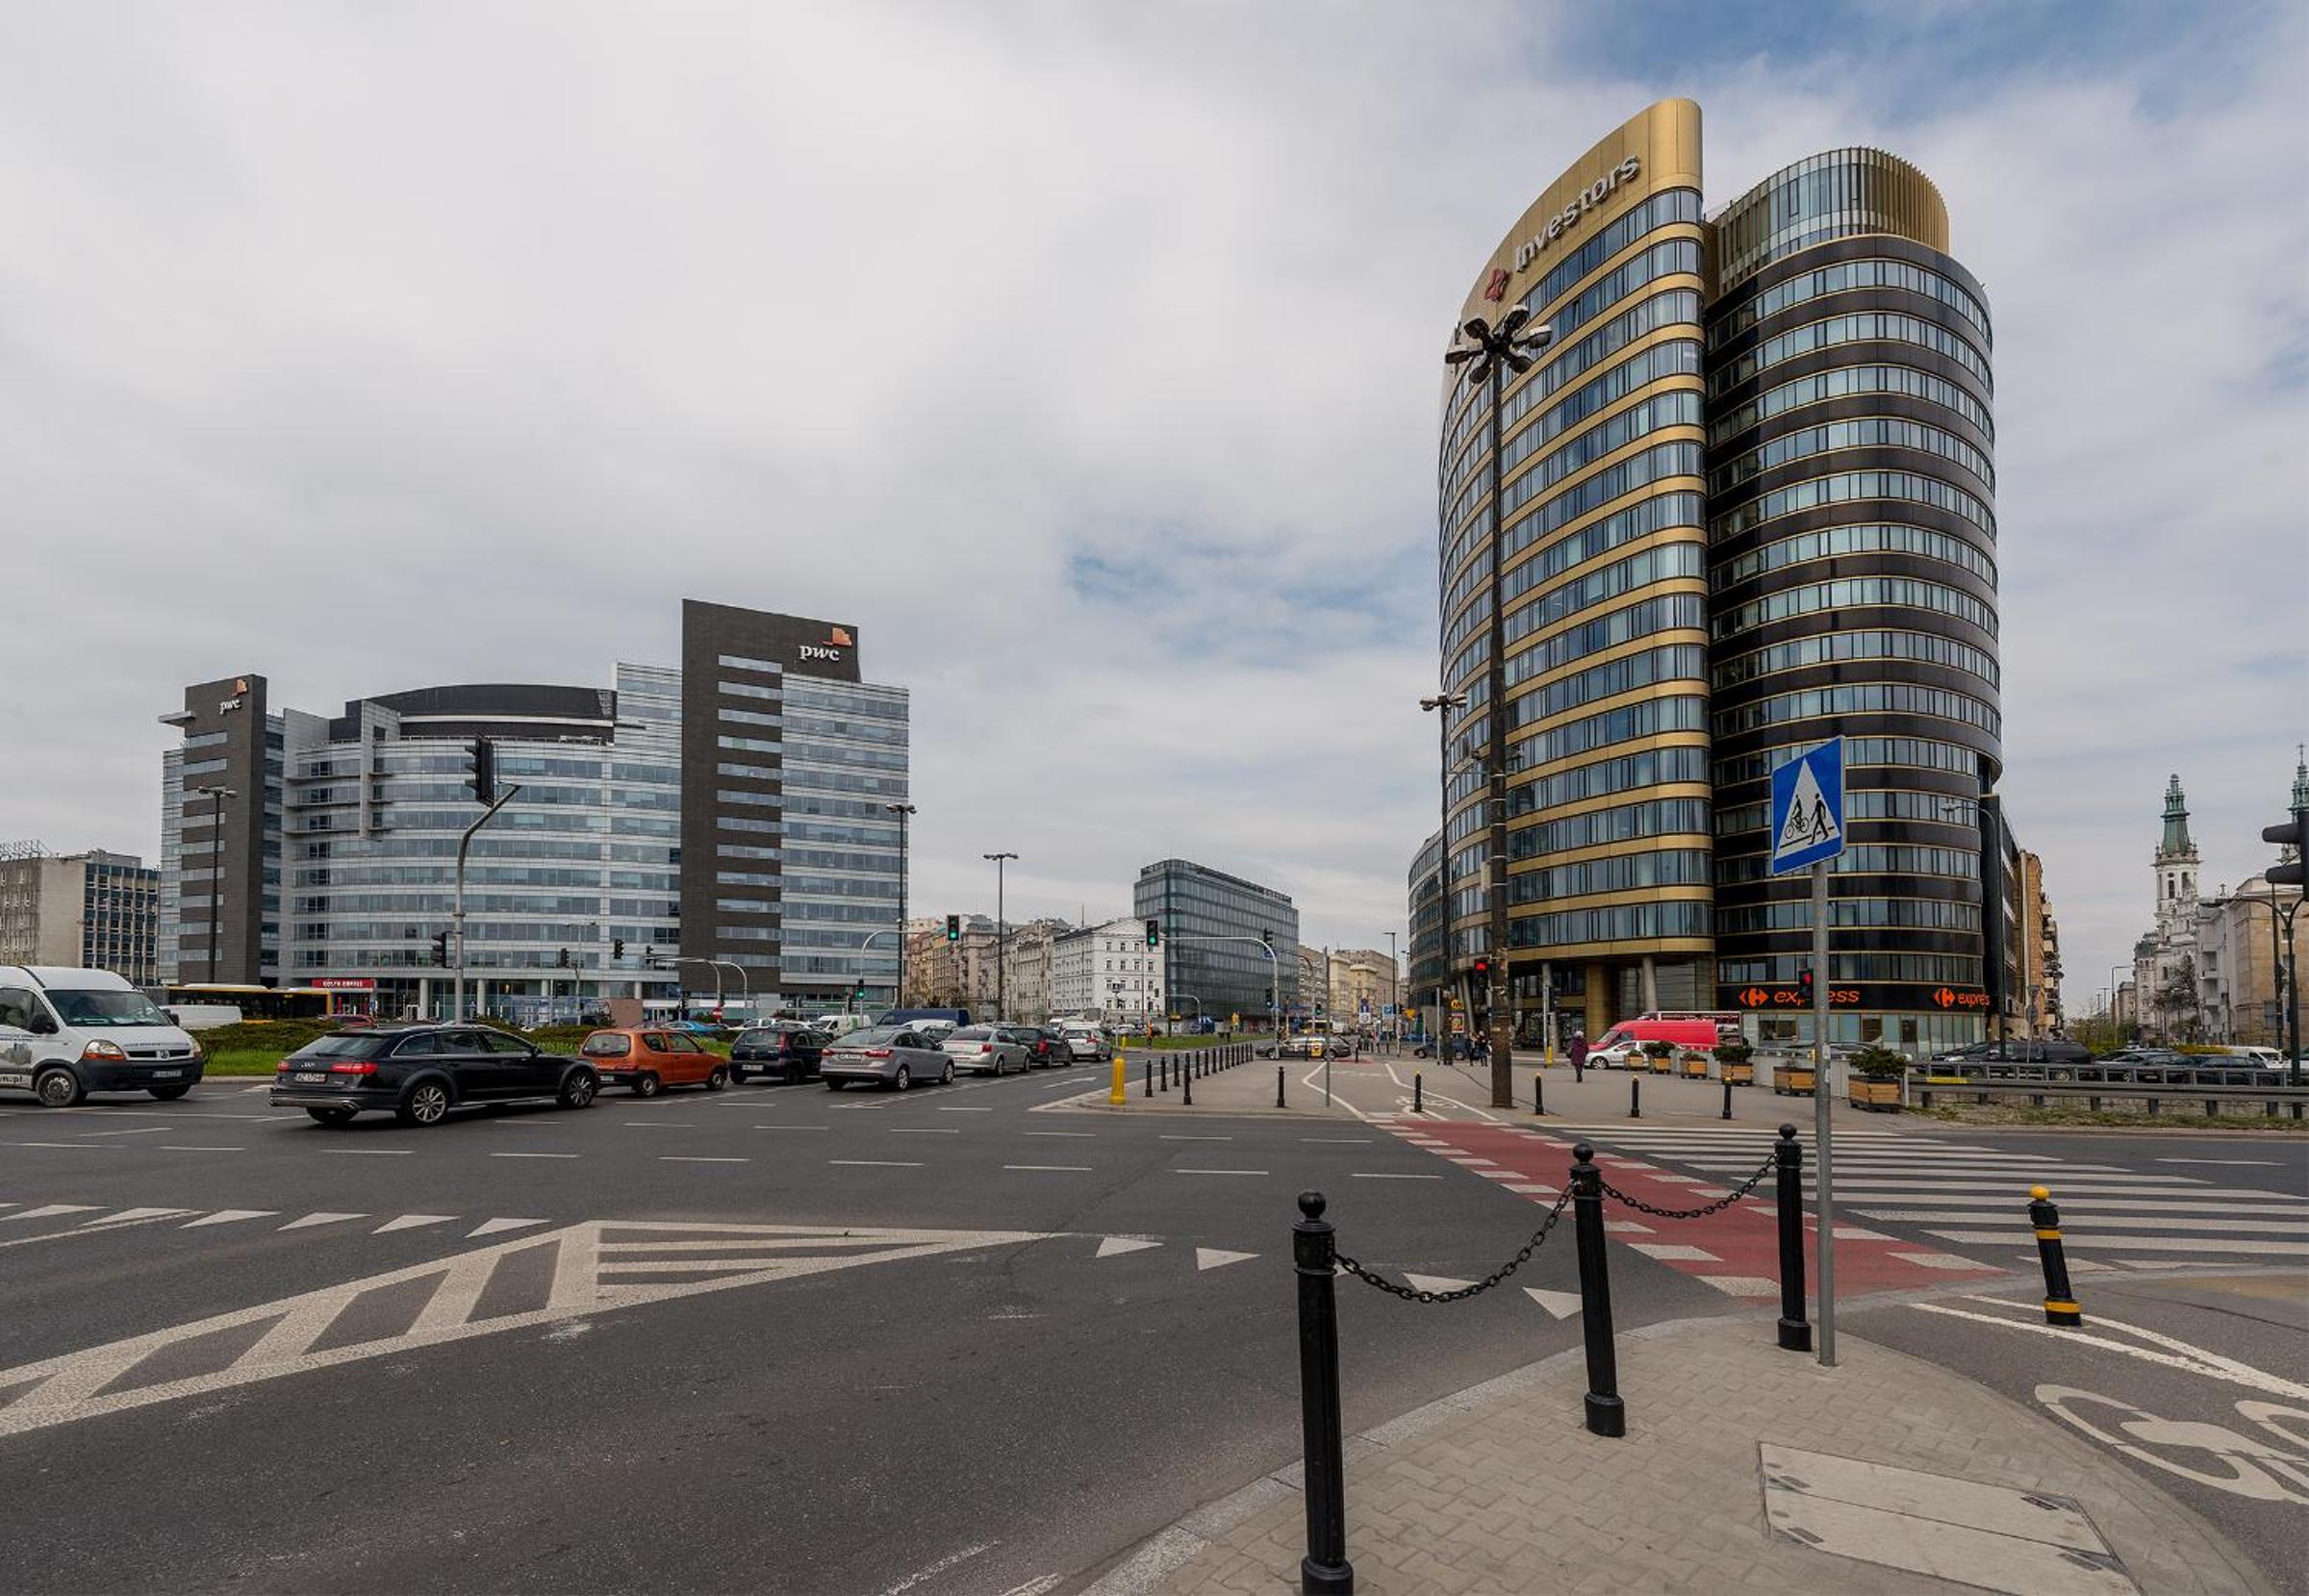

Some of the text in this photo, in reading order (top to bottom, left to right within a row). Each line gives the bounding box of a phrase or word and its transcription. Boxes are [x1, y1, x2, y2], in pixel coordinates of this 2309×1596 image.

[799, 646, 840, 661] pwc
[219, 699, 241, 715] pwc
[1773, 990, 1860, 1006] exess
